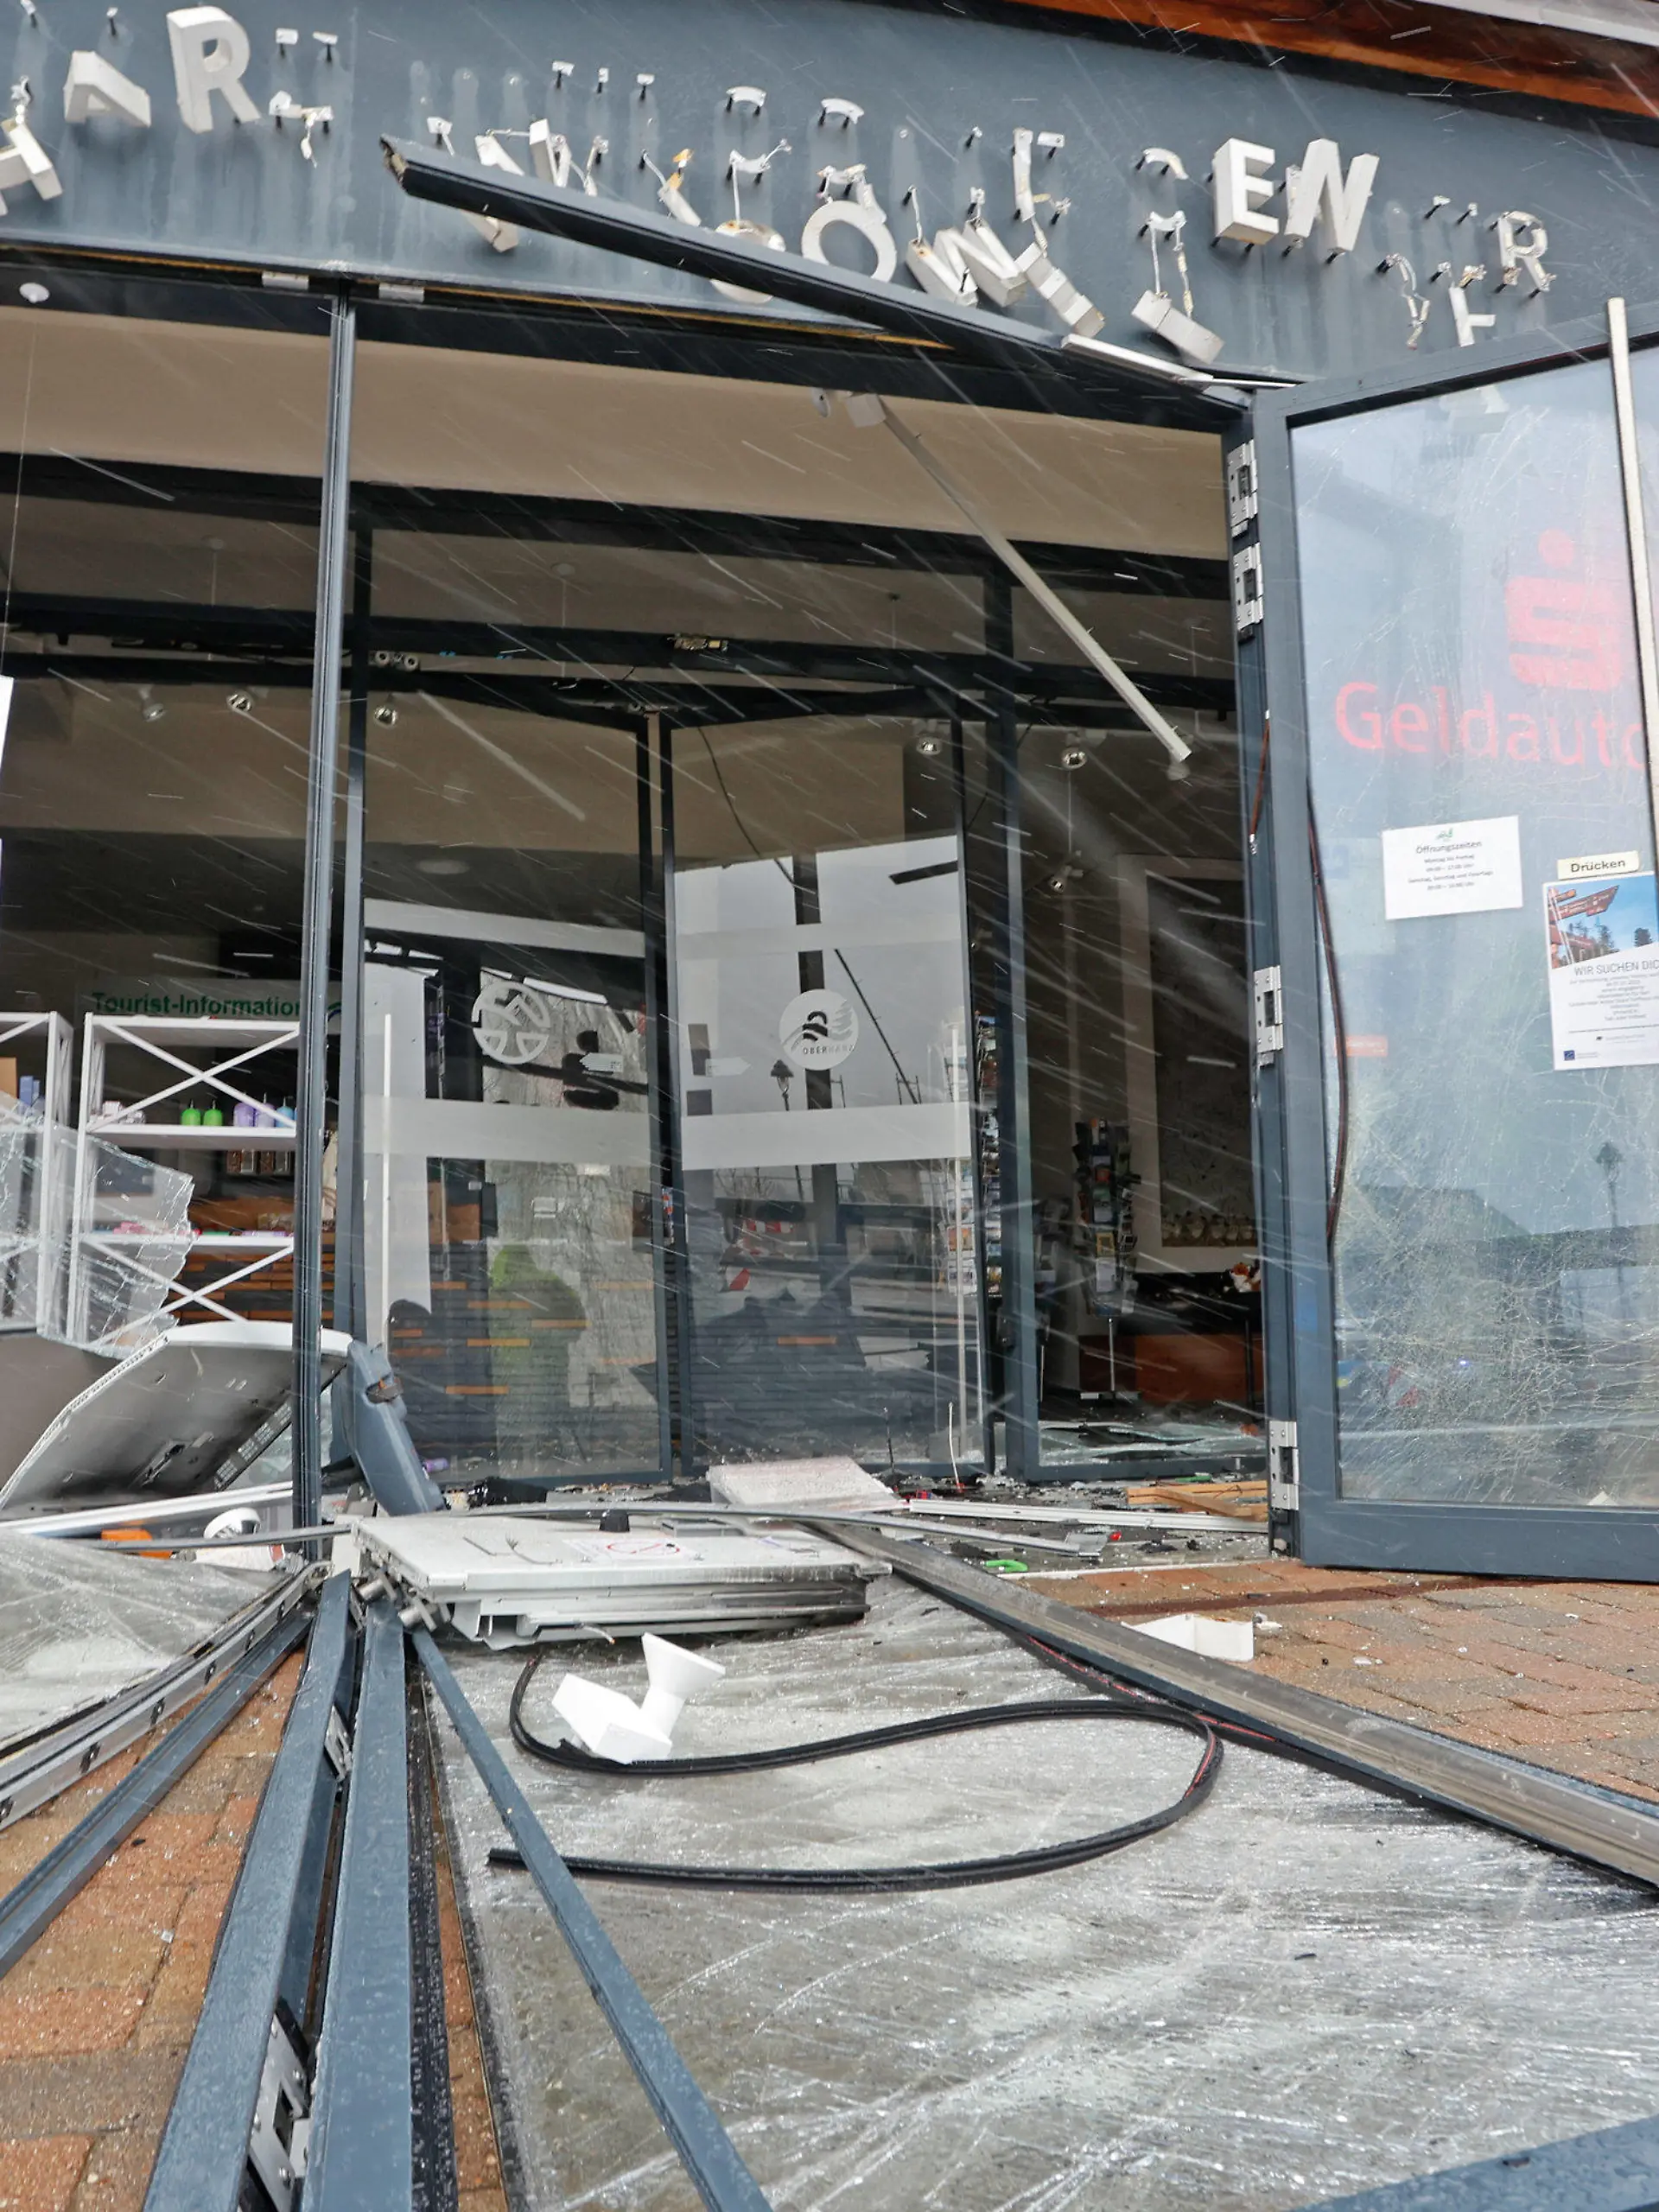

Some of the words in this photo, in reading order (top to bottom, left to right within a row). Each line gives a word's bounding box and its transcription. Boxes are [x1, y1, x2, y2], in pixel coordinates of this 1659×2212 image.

[1415, 841, 1483, 854] Öffnungszeiten
[1570, 860, 1626, 873] Drücken
[1573, 965, 1594, 976] WIR
[1596, 961, 1639, 975] SUCHEN
